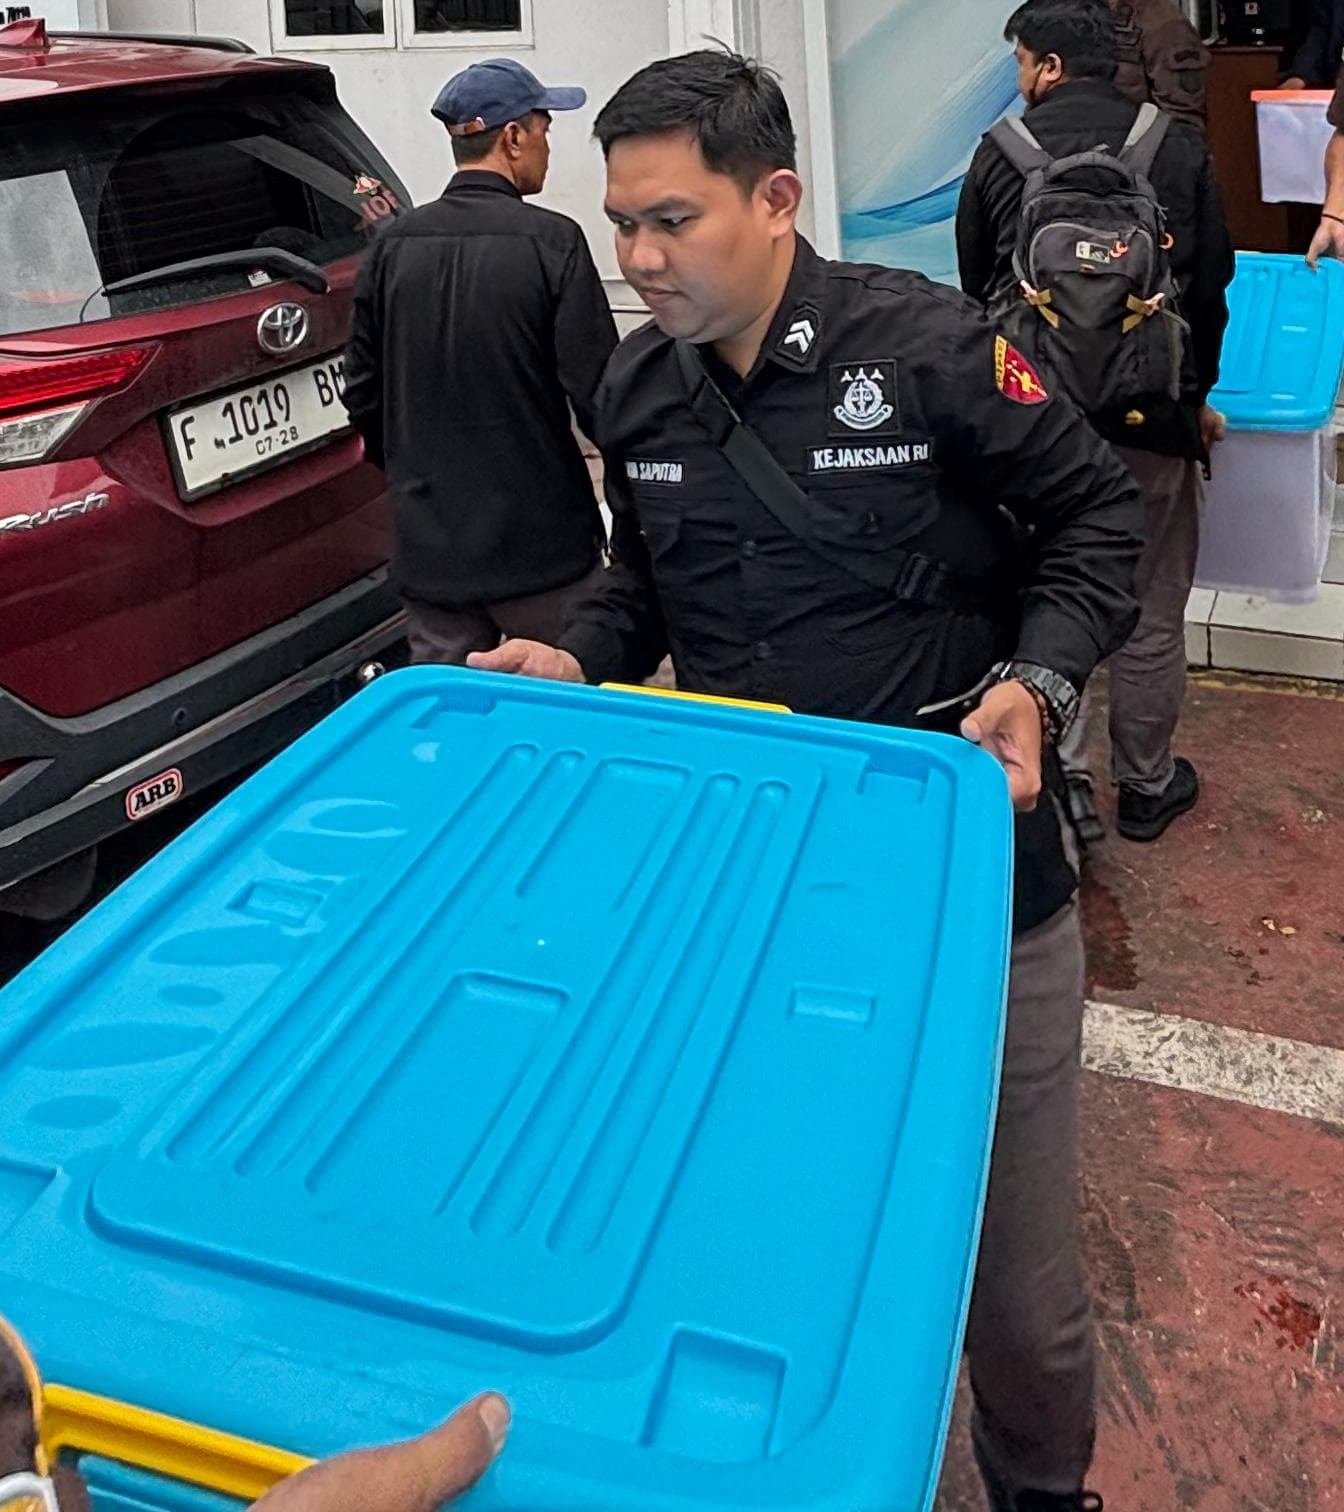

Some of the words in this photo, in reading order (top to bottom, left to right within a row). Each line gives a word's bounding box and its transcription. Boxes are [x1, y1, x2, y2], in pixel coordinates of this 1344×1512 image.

[180, 416, 196, 461] F
[222, 382, 292, 445] 1019
[813, 444, 911, 470] KEJAKSAAN
[912, 443, 929, 461] RI
[639, 462, 683, 483] SAPUTRA
[134, 777, 177, 812] ARB
